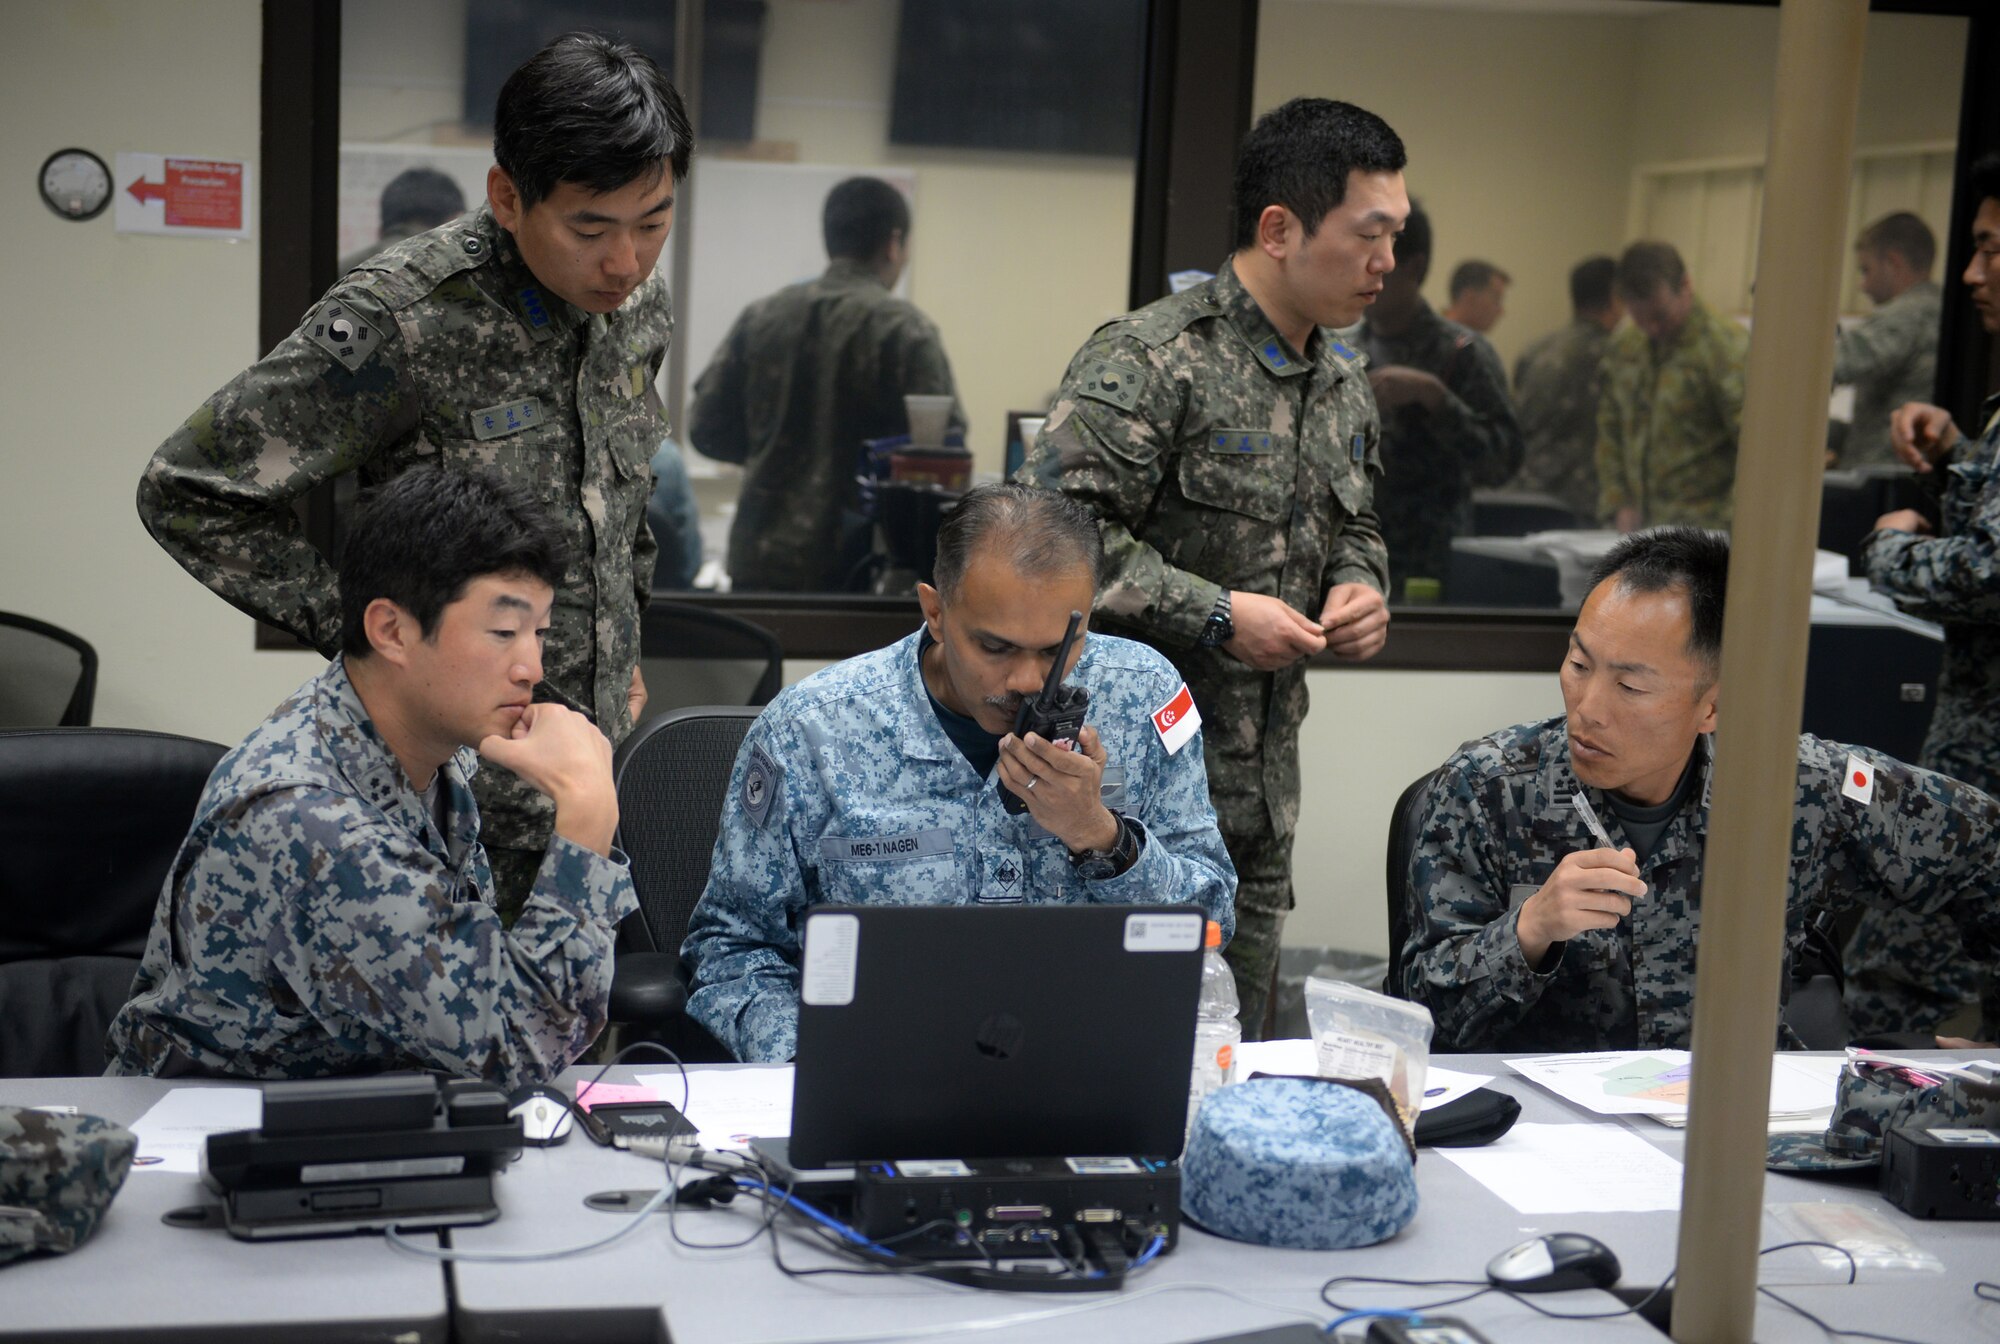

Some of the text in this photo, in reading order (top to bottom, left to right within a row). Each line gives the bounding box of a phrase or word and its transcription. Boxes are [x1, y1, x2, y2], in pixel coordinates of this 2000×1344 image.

[760, 755, 774, 777] FORCE
[851, 838, 919, 857] ME6-1 NAGEN
